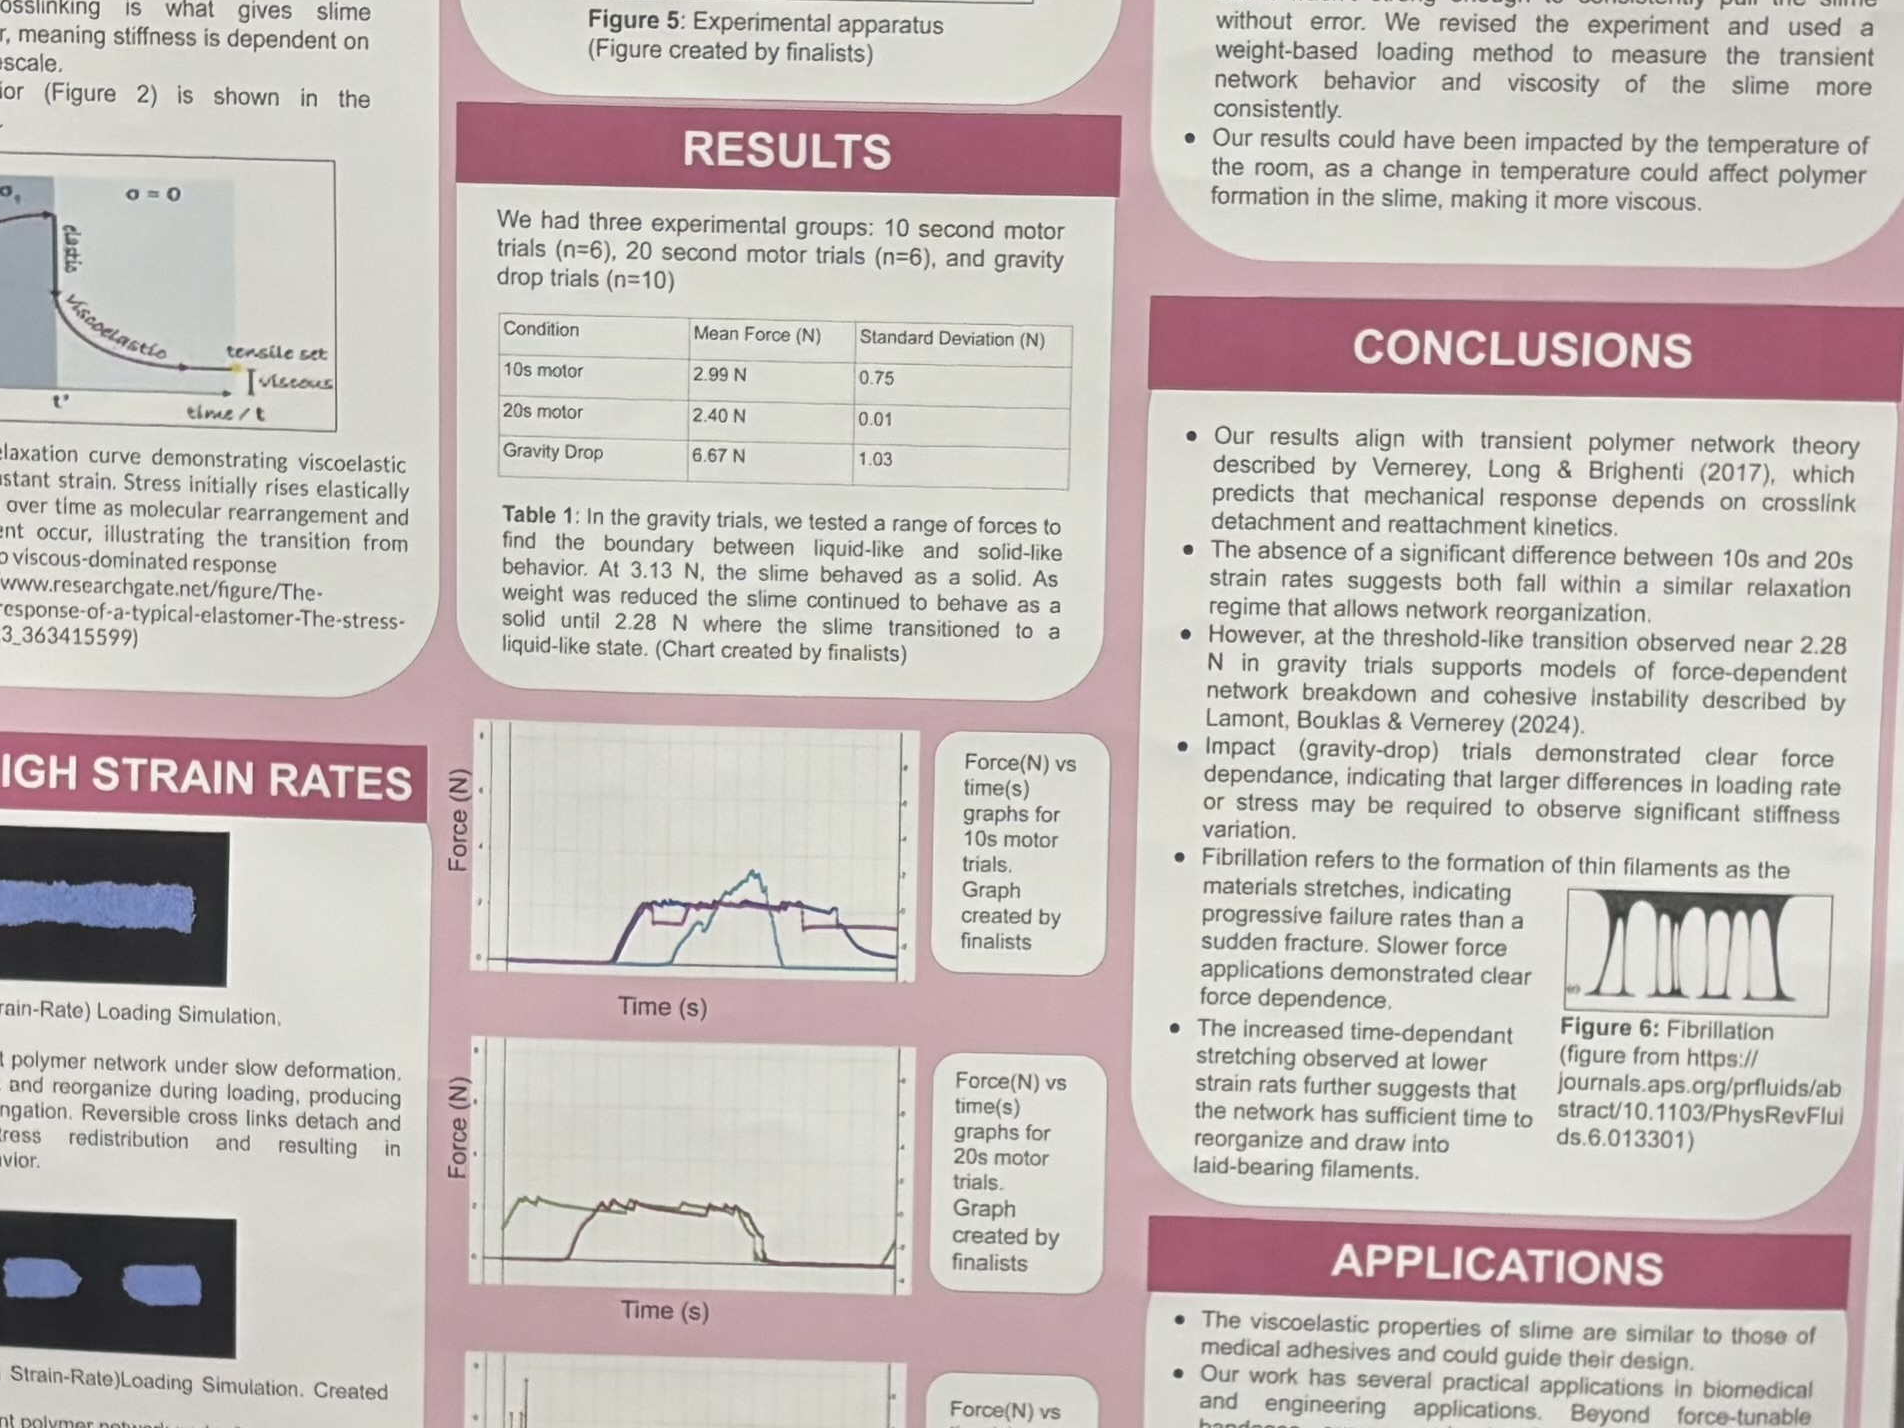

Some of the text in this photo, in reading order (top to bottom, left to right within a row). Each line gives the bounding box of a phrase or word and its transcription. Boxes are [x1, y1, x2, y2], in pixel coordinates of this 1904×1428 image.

[684, 130, 891, 171] RESULTS
[503, 320, 580, 338] Condition
[694, 325, 821, 346] Mean Force (N)
[860, 329, 1046, 351] Standard Deviation (N)
[1353, 329, 1693, 369] CONCLUSIONS
[504, 362, 583, 380] 10s motor
[693, 366, 746, 383] 2.99 N
[859, 370, 894, 387] 0.75
[93, 756, 253, 795] STRAIN
[270, 762, 413, 801] RATES
[449, 768, 473, 872] Force (N)
[618, 996, 707, 1022] Time (s)
[1561, 1016, 1775, 1040] Figure 6: Fibrillation
[1331, 1244, 1663, 1287] APPLICATIONS
